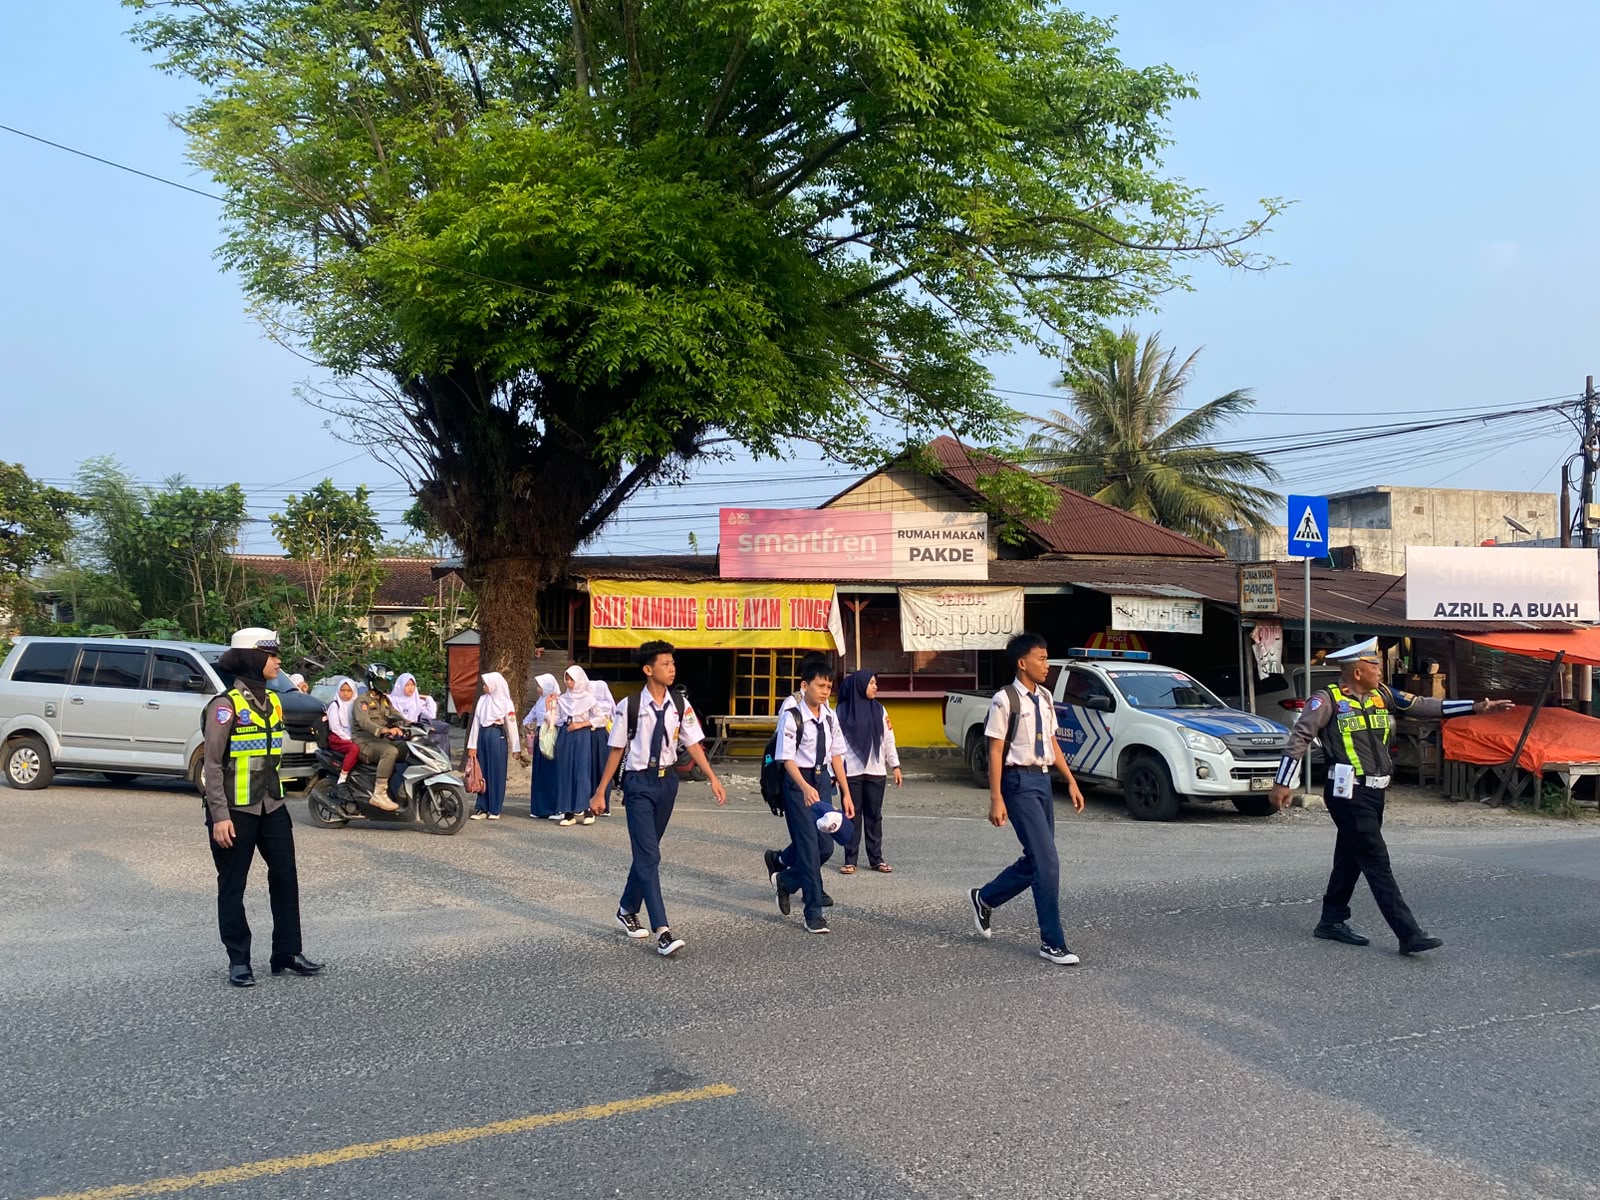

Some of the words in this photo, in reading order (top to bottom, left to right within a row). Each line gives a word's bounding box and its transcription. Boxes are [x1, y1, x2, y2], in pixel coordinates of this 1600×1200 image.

[738, 527, 877, 553] smartfren
[897, 529, 940, 540] RUMAH
[942, 530, 985, 540] MAKAN
[909, 547, 974, 562] PAKDE
[1244, 583, 1273, 595] PAKDE
[593, 595, 628, 629] SATE
[630, 596, 698, 630] KAMBING
[705, 597, 739, 631] SATE
[742, 598, 782, 631] AYAM
[1434, 602, 1488, 618] AZRIL
[1492, 602, 1523, 618] R.A
[1527, 602, 1579, 618] BUAH
[1107, 635, 1127, 643] POCI
[949, 696, 963, 704] PJR
[1056, 727, 1074, 738] OLISI
